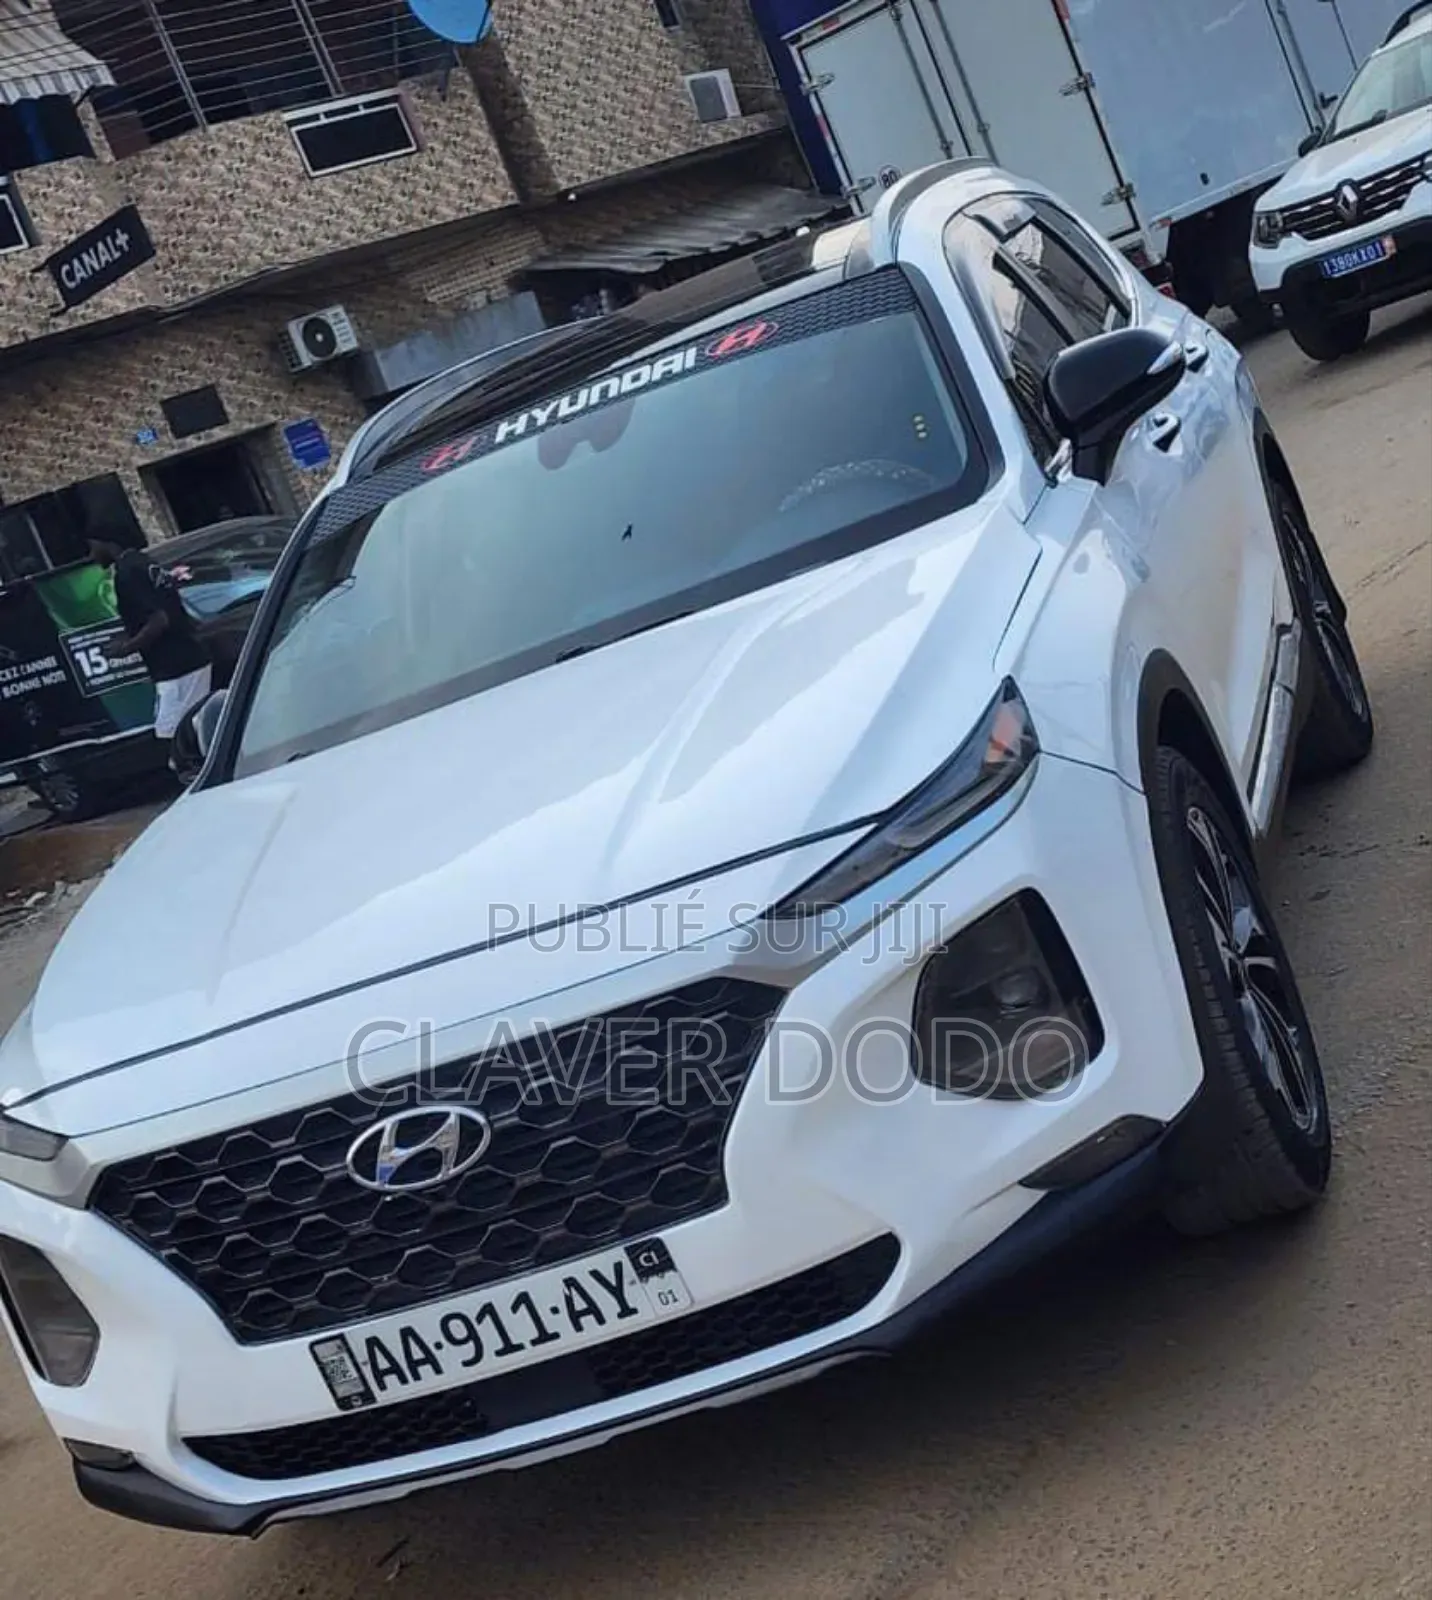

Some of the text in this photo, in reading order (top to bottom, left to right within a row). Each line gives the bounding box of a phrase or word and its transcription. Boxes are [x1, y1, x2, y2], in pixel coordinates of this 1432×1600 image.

[61, 228, 129, 289] CANAL+
[495, 347, 697, 444] HYUNDAI
[74, 646, 109, 678] 15
[639, 1251, 660, 1267] CI
[658, 1289, 679, 1306] 01
